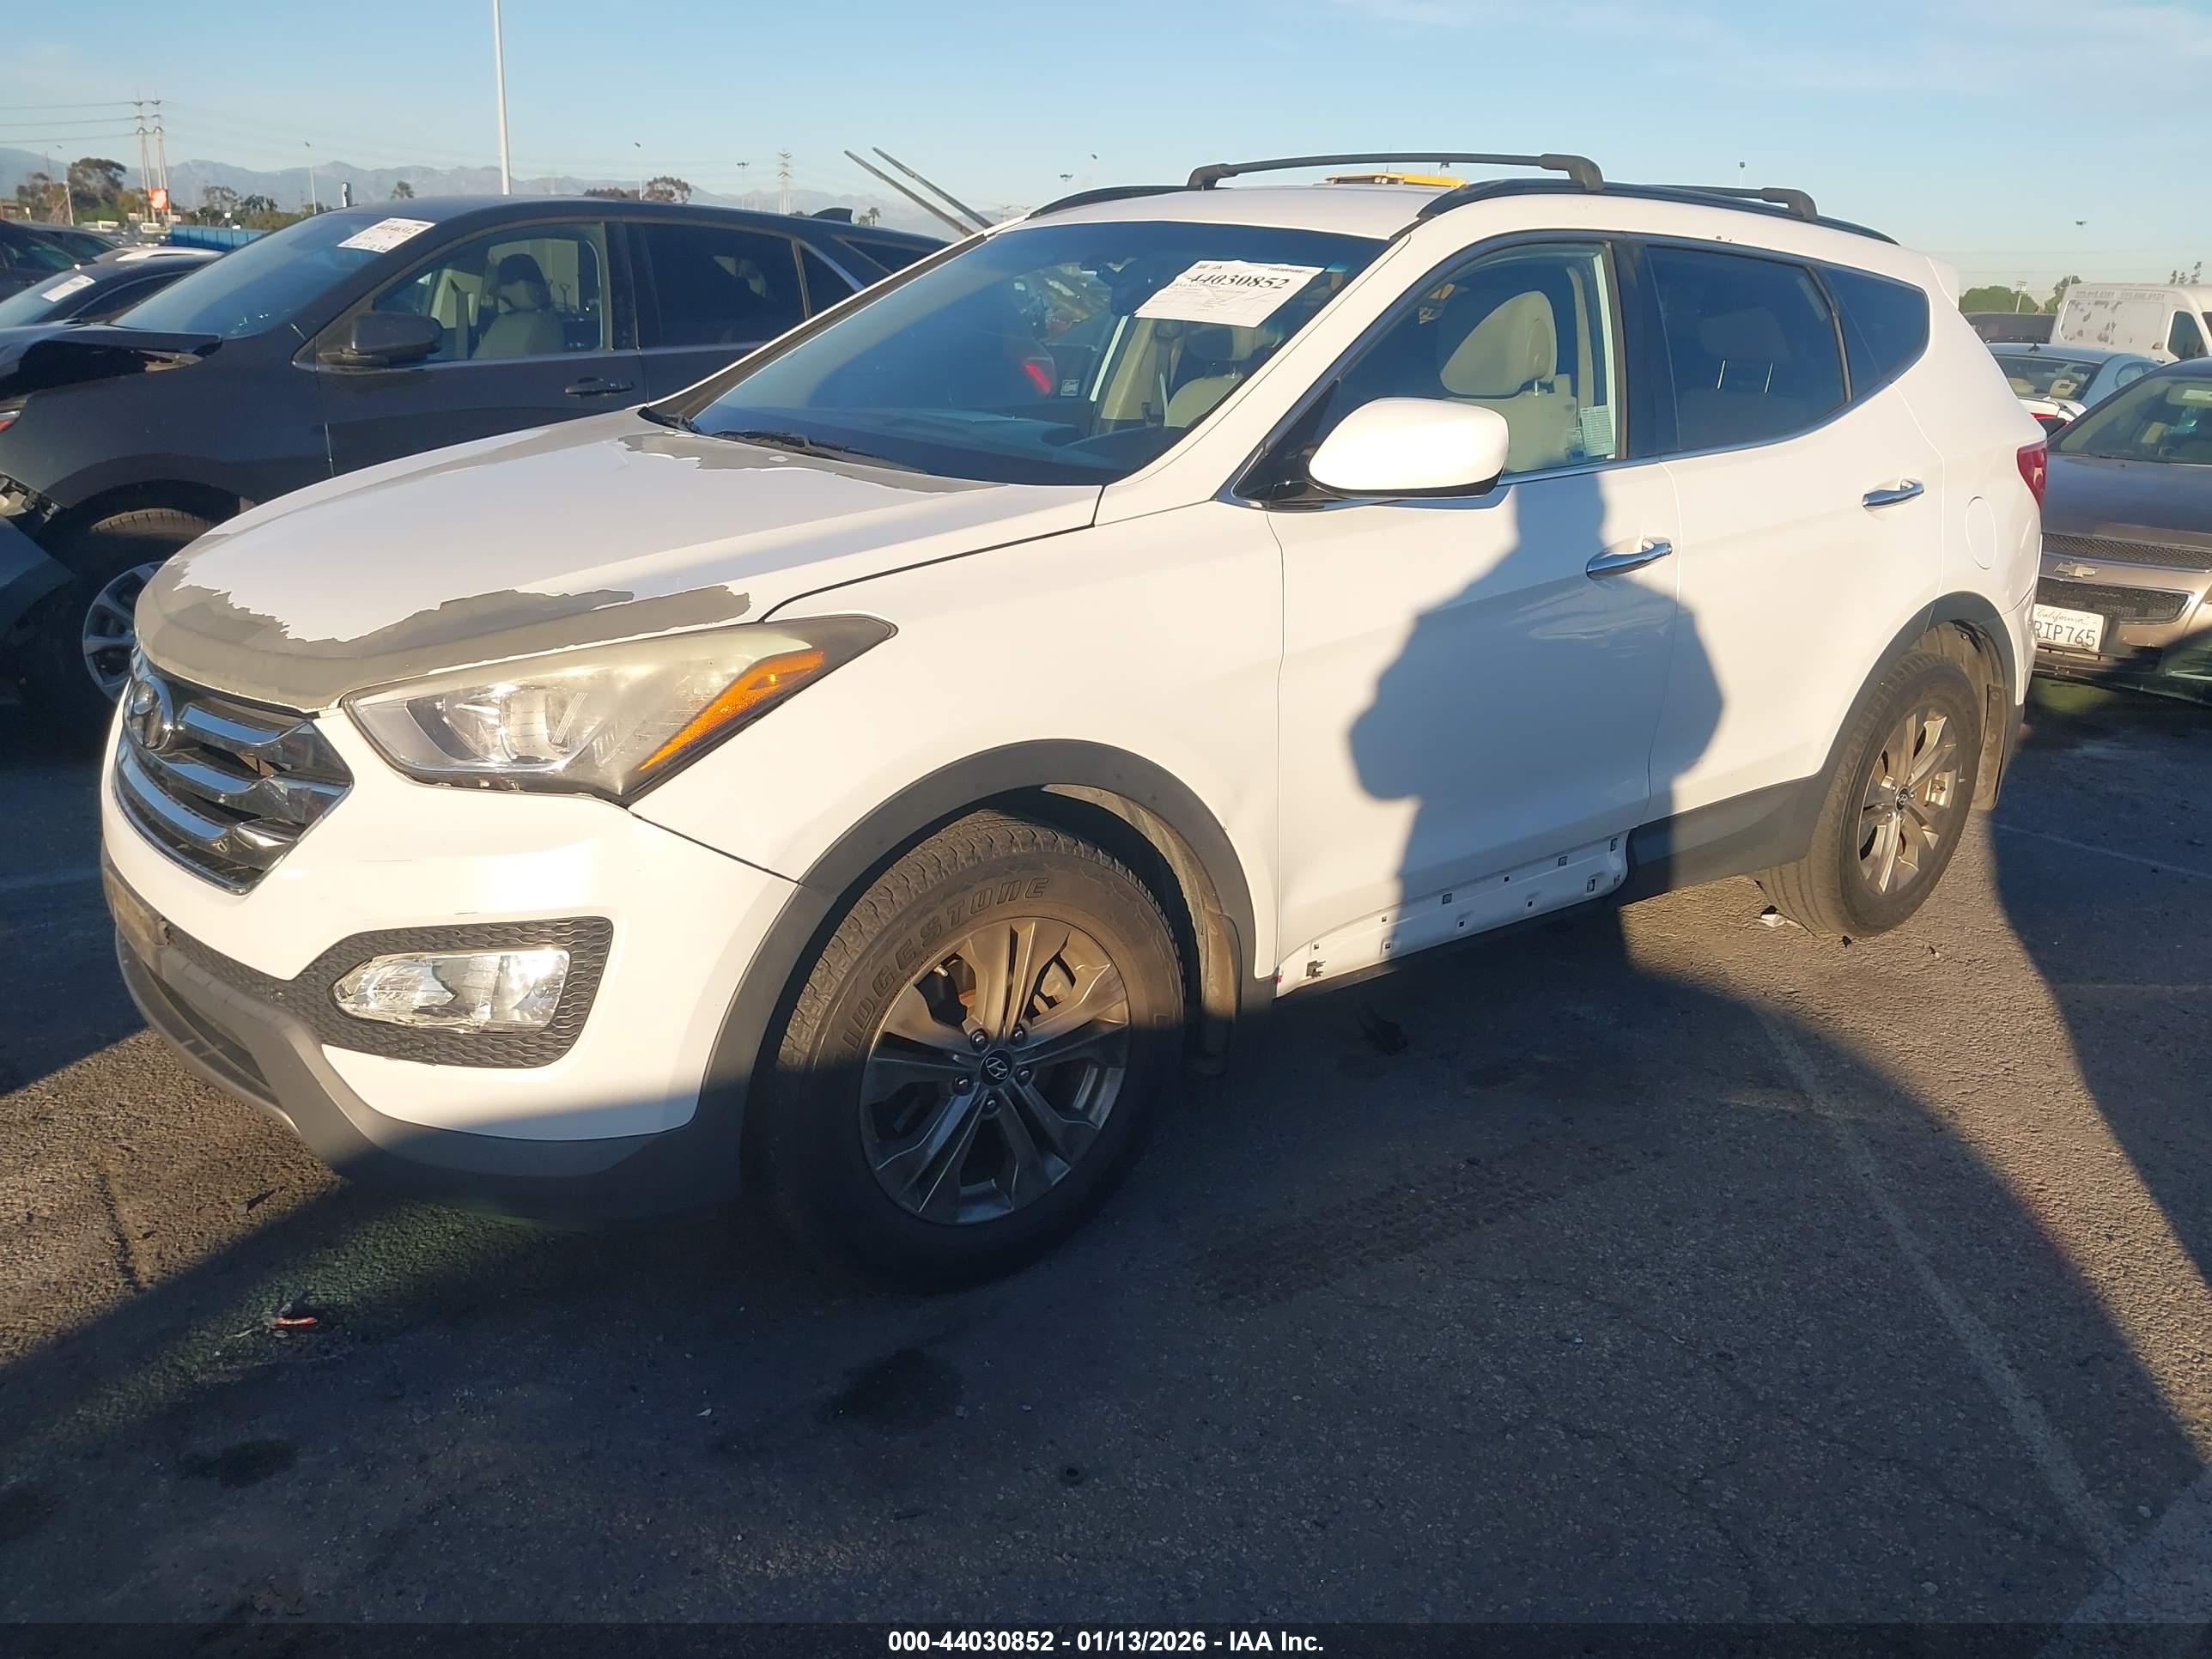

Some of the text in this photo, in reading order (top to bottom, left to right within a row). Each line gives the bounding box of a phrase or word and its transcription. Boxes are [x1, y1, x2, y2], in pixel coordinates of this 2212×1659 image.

[1188, 273, 1291, 289] 44030852
[2034, 620, 2096, 647] RIP765
[835, 876, 1049, 1069] IDGESTONE
